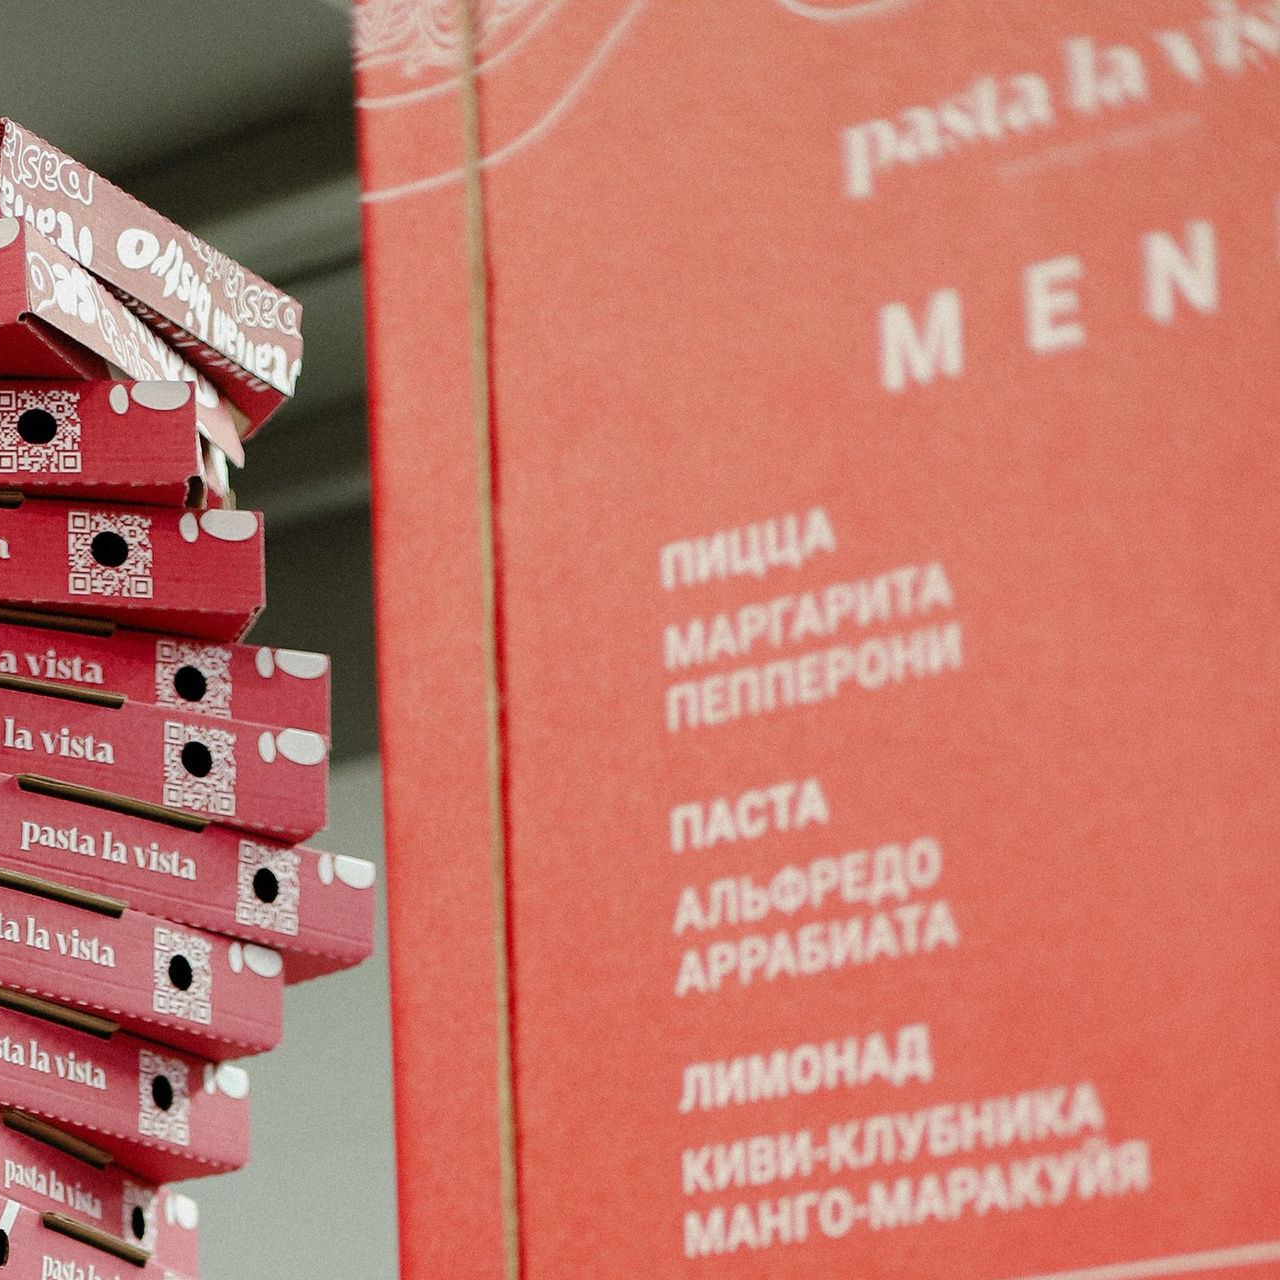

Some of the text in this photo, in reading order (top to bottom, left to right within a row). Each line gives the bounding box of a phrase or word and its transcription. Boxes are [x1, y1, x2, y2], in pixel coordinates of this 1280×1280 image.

[842, 73, 1054, 198] pasta
[1063, 36, 1149, 112] la
[877, 219, 1219, 393] MEN
[660, 507, 837, 592] ПИЦЦА
[663, 561, 954, 671] МАРГАРИТА
[24, 648, 104, 685] vista
[665, 622, 963, 733] ПЕППЕРОНИ
[4, 717, 35, 749] la
[39, 726, 116, 765] vista
[21, 818, 197, 881] pasta la vista
[669, 777, 829, 854] ПАСТА
[673, 837, 942, 935] АЛЬФРЕДО
[26, 916, 53, 951] la
[55, 925, 116, 968] vista
[674, 901, 959, 997] АРРАБИАТА
[29, 1039, 52, 1071] la
[54, 1048, 107, 1091] vista
[678, 1024, 934, 1114] ЛИМОНАД
[682, 1082, 1105, 1196] КИВИ-КЛУБНИКА
[3, 1158, 103, 1220] pasta la vista
[684, 1136, 1150, 1258] МАНГО-МАРАКУЙЯ
